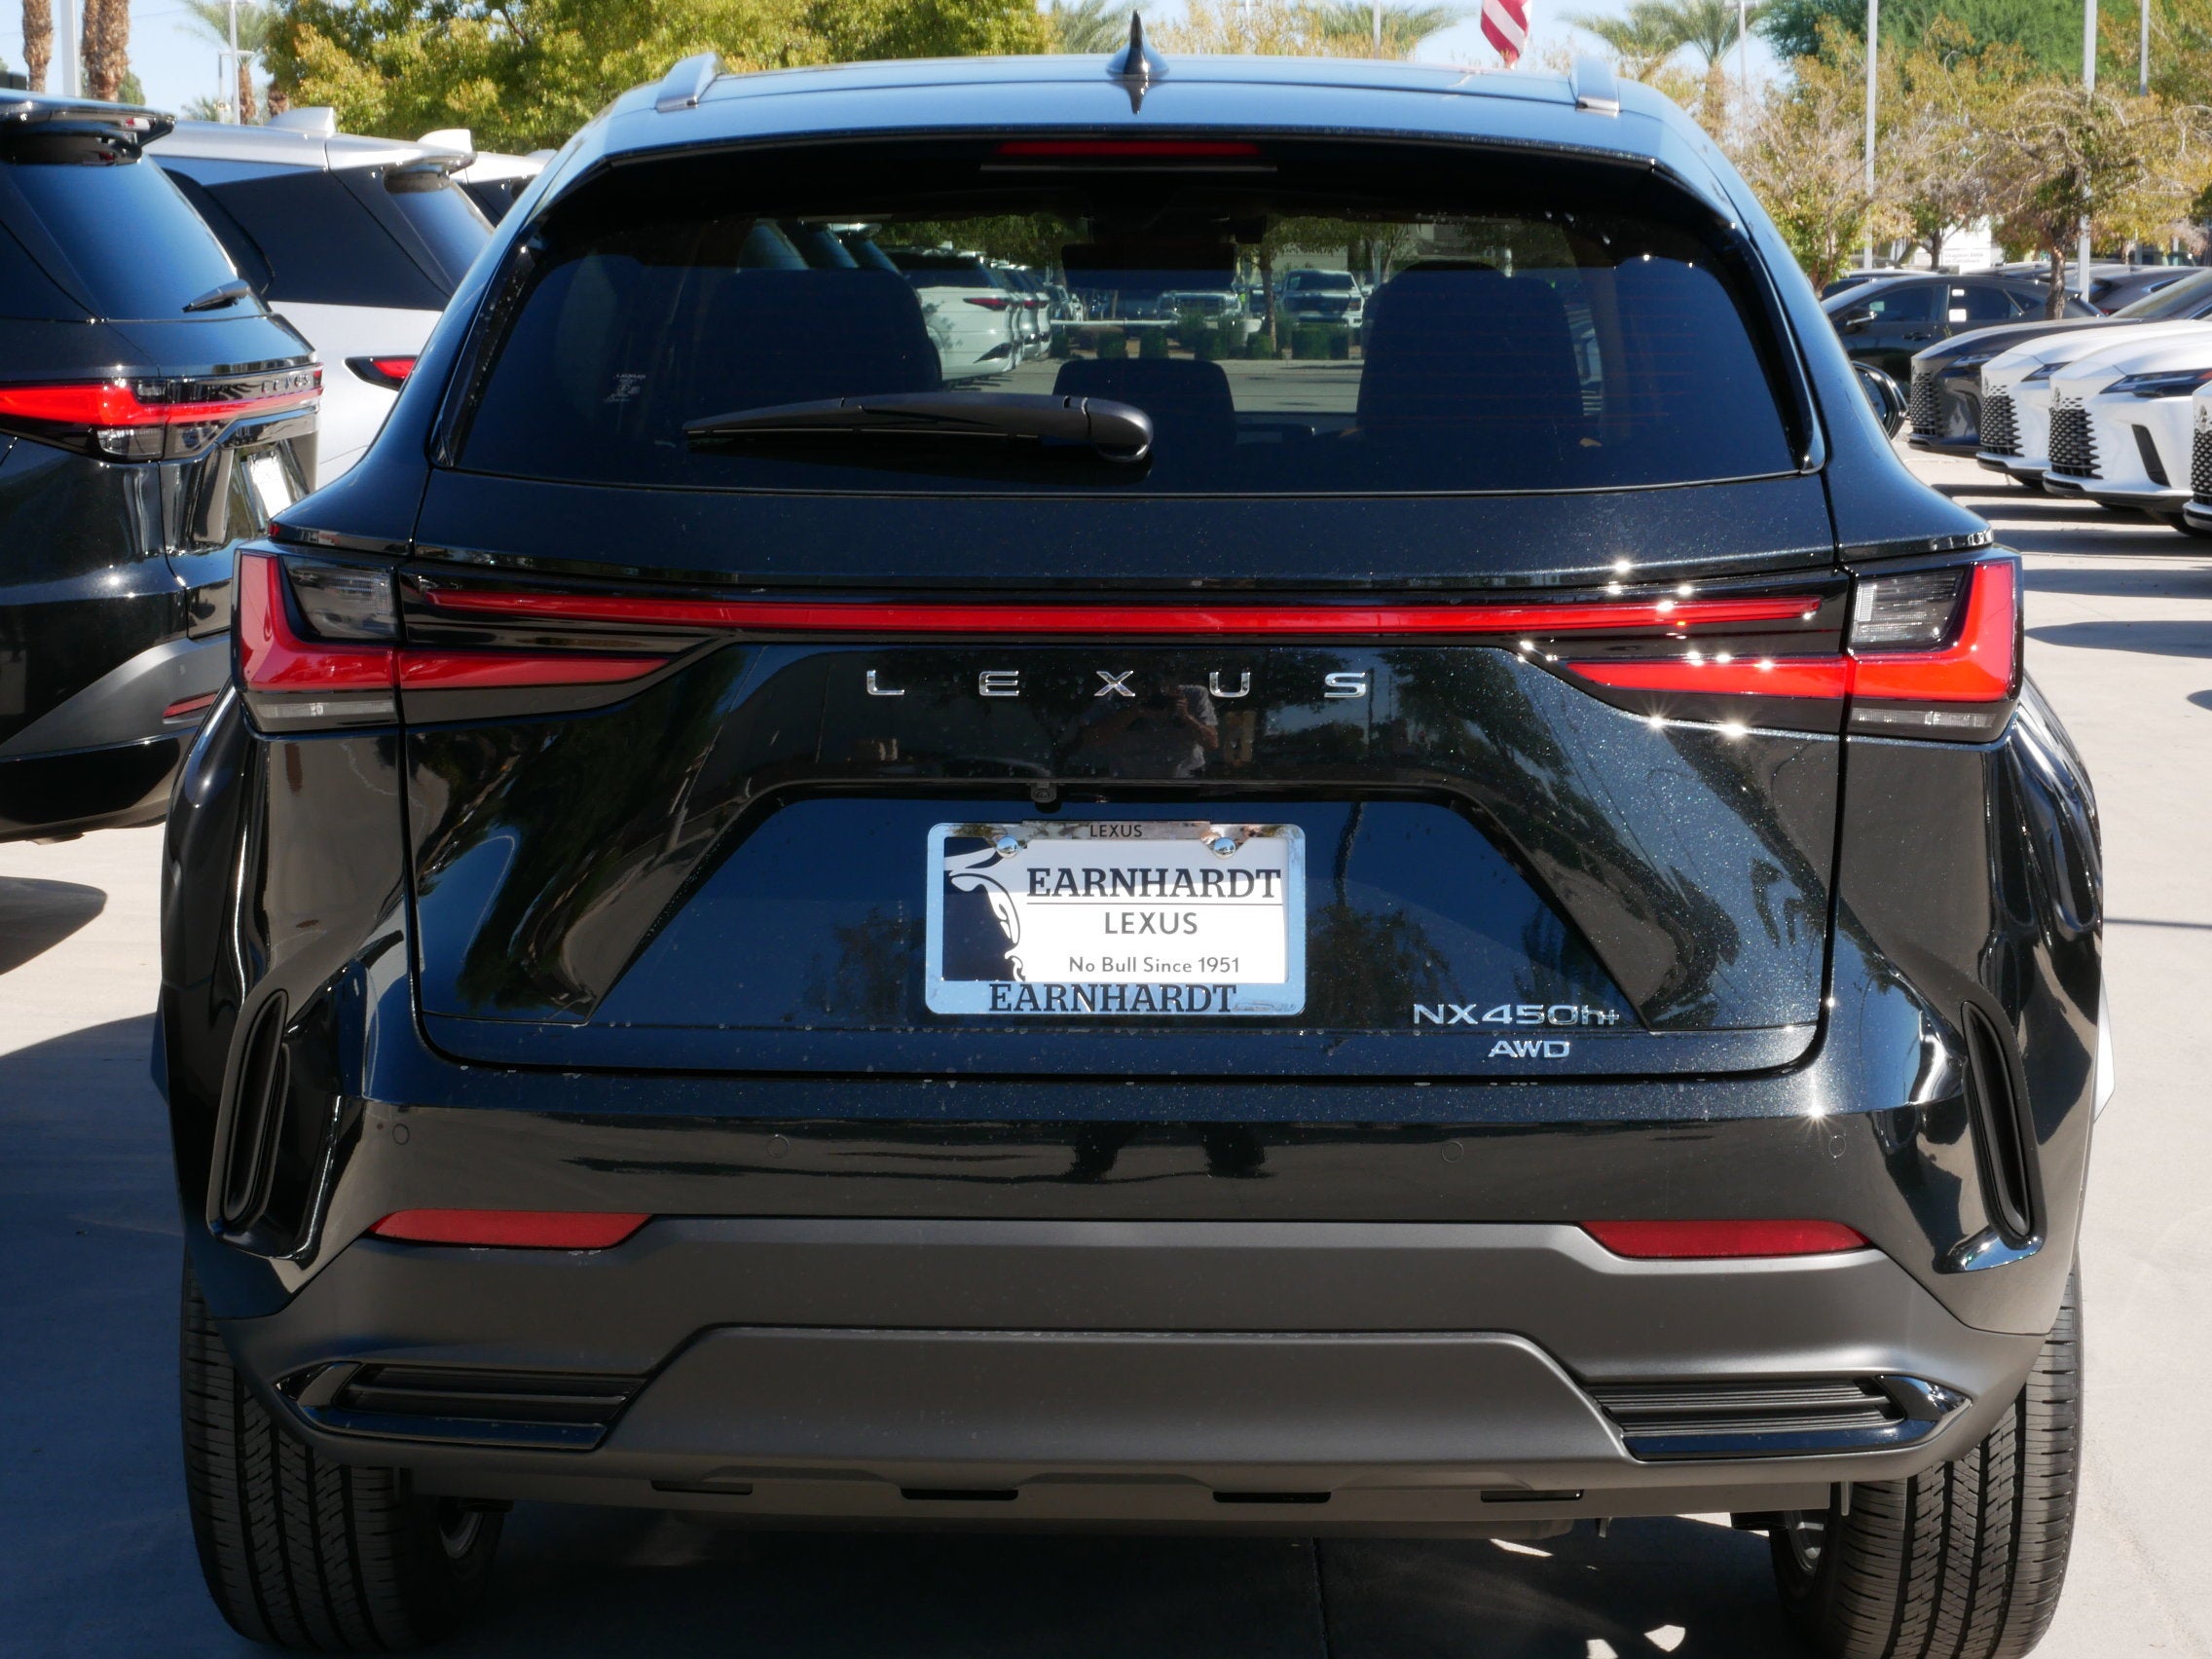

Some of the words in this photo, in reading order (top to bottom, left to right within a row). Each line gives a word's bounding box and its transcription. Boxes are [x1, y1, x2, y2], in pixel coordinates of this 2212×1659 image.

[866, 670, 1367, 699] LEXUS
[1089, 824, 1143, 838] LEXUS
[1026, 866, 1281, 899] EARNHARDT
[1104, 911, 1198, 936] LEXUS
[1069, 956, 1095, 973] No
[1102, 956, 1137, 973] Bull
[1143, 956, 1193, 974] Since
[1198, 956, 1240, 974] 1951
[988, 982, 1237, 1014] EARNHARDT
[1488, 1040, 1571, 1058] AWD
